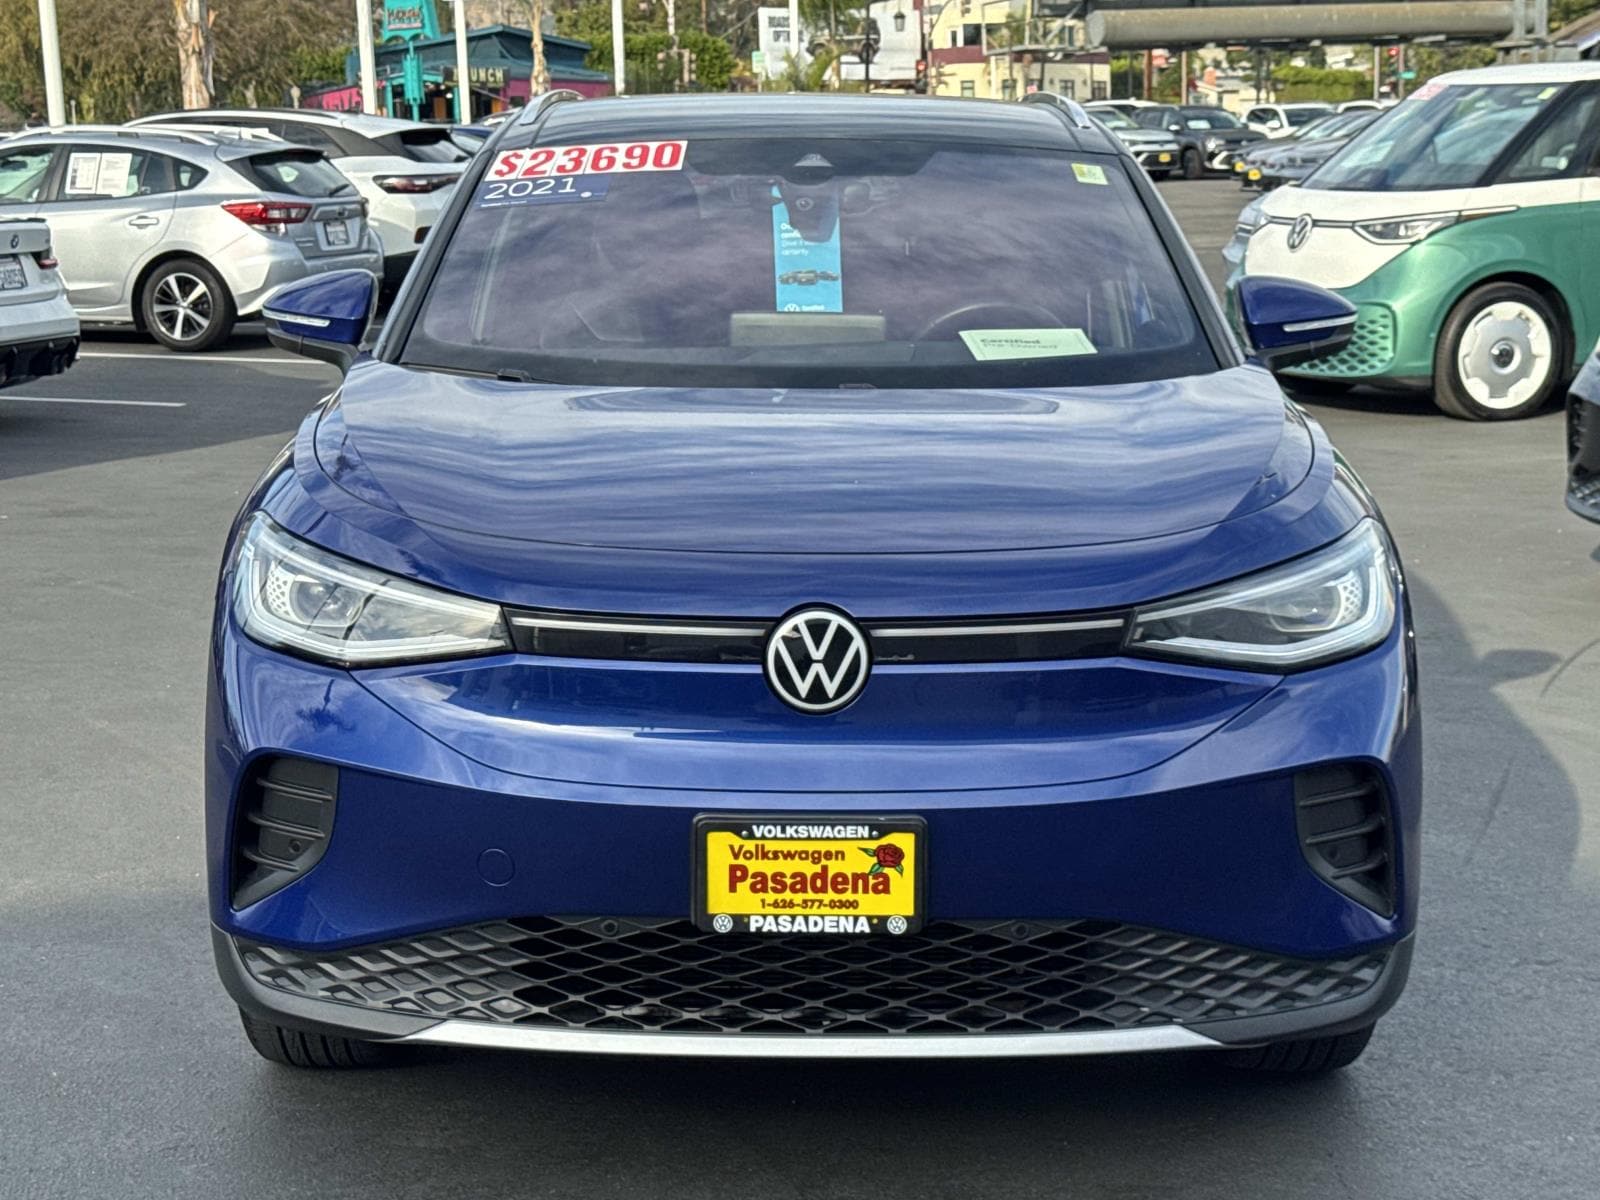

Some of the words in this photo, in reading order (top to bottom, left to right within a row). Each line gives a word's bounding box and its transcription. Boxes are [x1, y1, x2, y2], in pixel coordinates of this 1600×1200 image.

[495, 143, 683, 177] $23690
[484, 177, 577, 199] 2021
[752, 825, 869, 839] VOLKSWAGEN
[729, 844, 846, 864] Volkswagen
[729, 864, 891, 894] Pasadena
[760, 898, 860, 910] 1-626-577-0300
[750, 915, 871, 933] PASADENA
